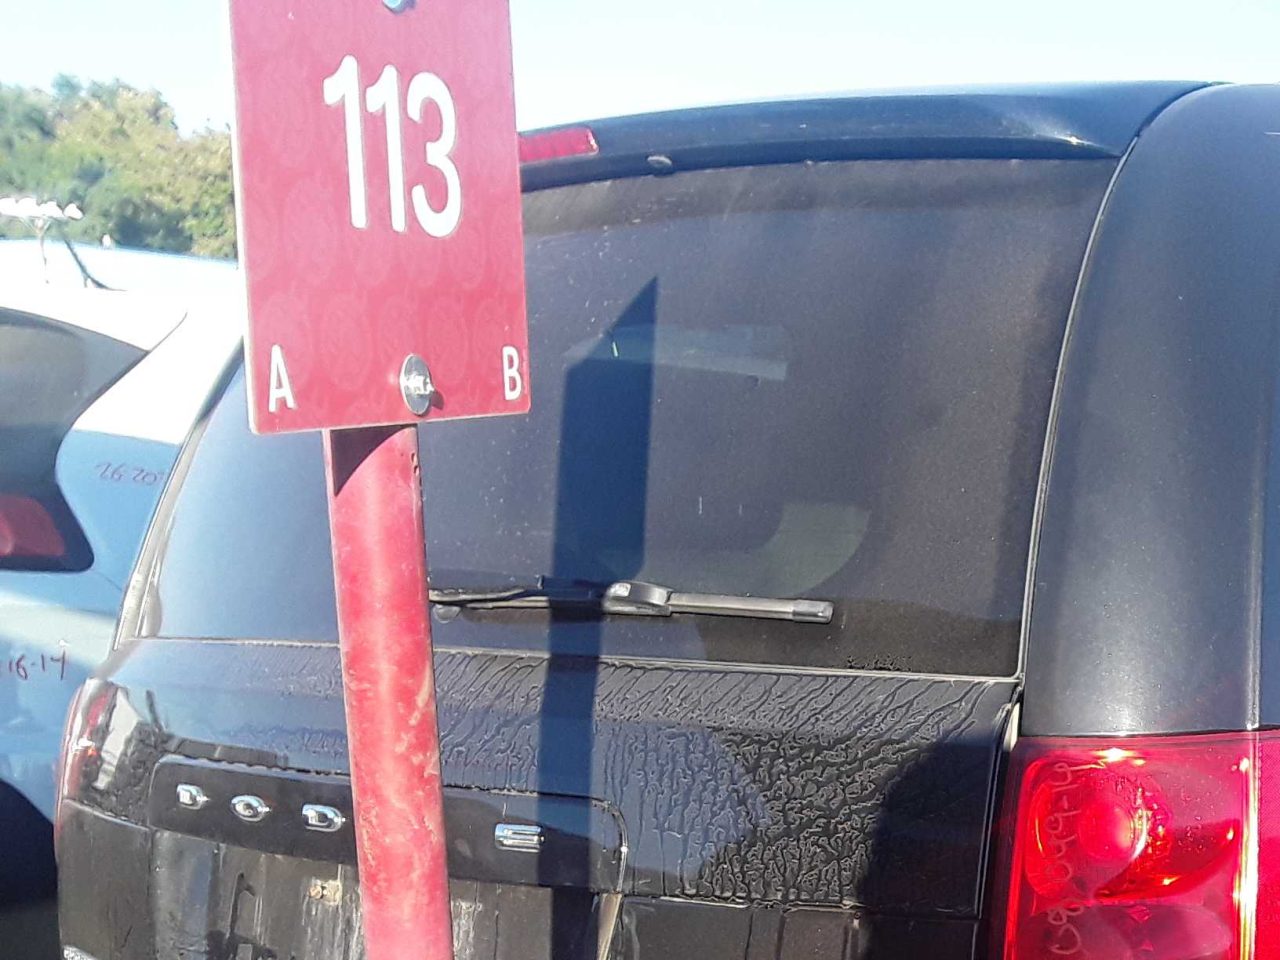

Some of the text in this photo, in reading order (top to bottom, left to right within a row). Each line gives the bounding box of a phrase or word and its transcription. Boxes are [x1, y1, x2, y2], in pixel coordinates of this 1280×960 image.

[323, 54, 463, 238] 113
[267, 344, 297, 413] A
[501, 345, 523, 401] B
[175, 782, 546, 853] DODE
